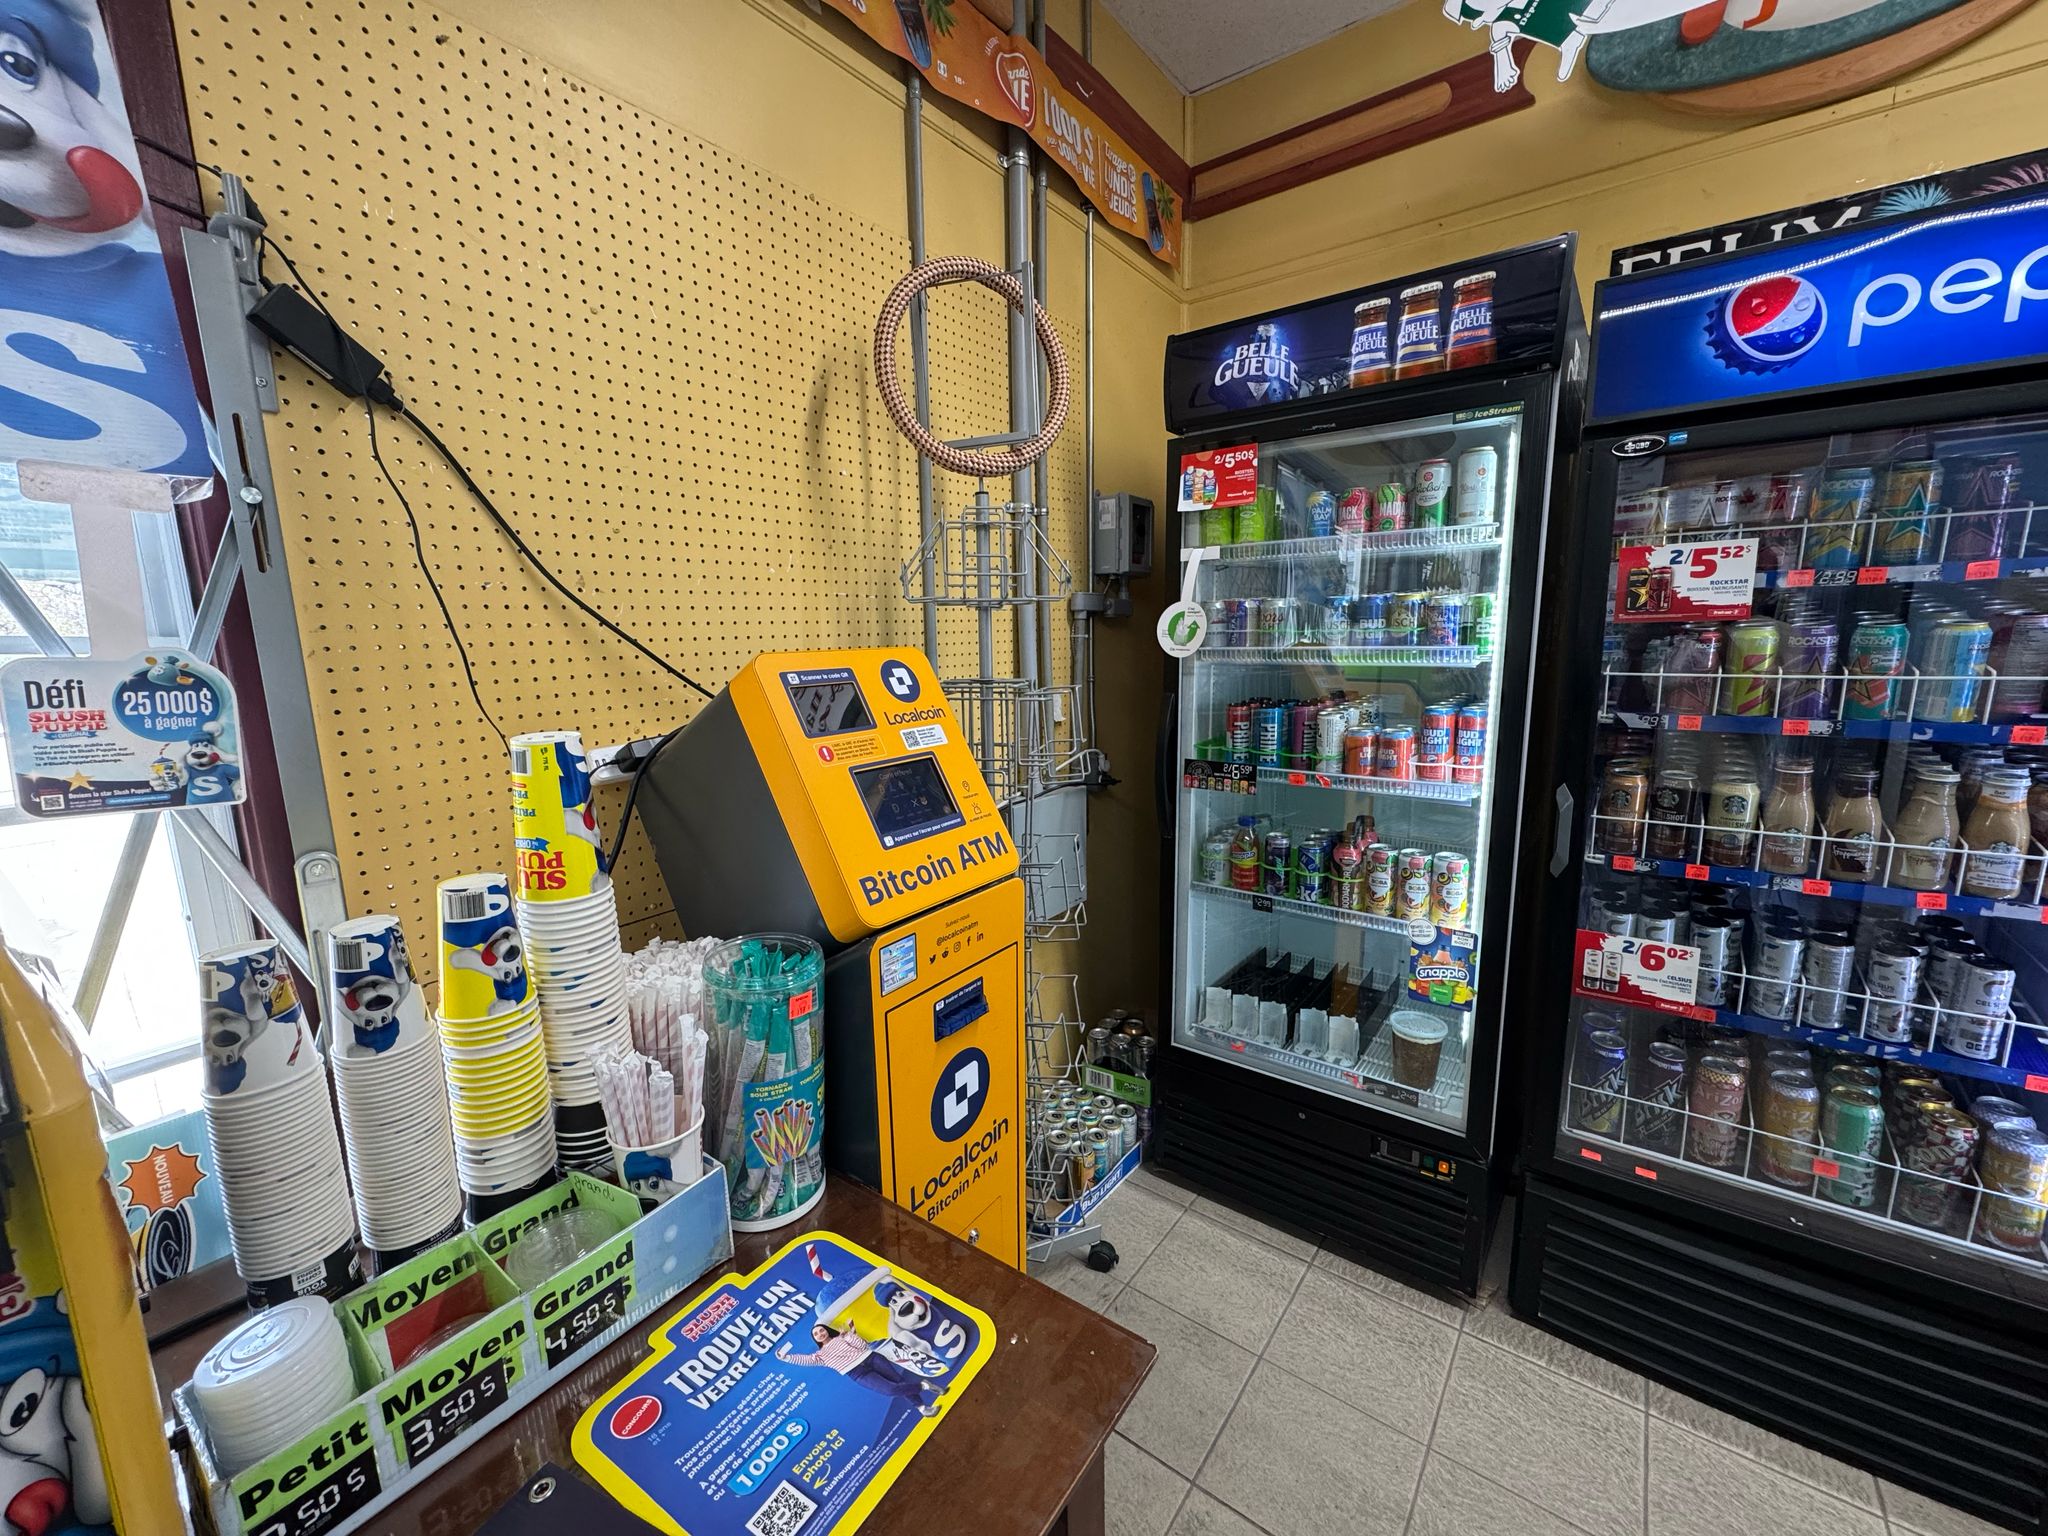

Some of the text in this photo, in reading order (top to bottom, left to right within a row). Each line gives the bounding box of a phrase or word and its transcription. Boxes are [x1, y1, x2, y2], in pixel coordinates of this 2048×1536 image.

[1104, 161, 1136, 205] LUNDIS
[1109, 197, 1138, 224] JEUDIS
[1405, 319, 1433, 334] BELLE
[1451, 312, 1493, 332] GUEULE
[1459, 307, 1488, 320] BELLE
[1234, 342, 1290, 363] BELLE
[1352, 336, 1388, 355] GUEULE
[1358, 330, 1383, 343] BELLE
[1398, 325, 1440, 346] GUEULE
[1214, 357, 1299, 392] GUEULE
[1474, 405, 1521, 418] IceStream
[1710, 578, 1749, 586] ROCKSTAR
[1359, 618, 1387, 629] BUD
[23, 679, 86, 710] Défi
[122, 691, 150, 716] 25
[29, 709, 106, 723] SLUSH
[144, 716, 198, 731] à gagner
[883, 705, 946, 726] Localcoin
[1423, 728, 1445, 737] BUD
[1458, 729, 1479, 738] BUD
[1233, 720, 1250, 763] PRIME
[1260, 723, 1278, 764] PRIME
[191, 776, 223, 797] S
[858, 831, 1009, 908] Bitcoin ATM
[936, 920, 979, 946] @localcoinatm
[1419, 966, 1466, 981] snapple
[1667, 974, 1693, 984] CELSIUS
[755, 1082, 789, 1092] TORNADO
[153, 1154, 174, 1204] NOUVEAU
[910, 1118, 1009, 1214] Localcoin
[573, 1175, 616, 1202] grand
[927, 1151, 998, 1222] Bitcoin ATM
[1082, 1168, 1121, 1211] BUD LIGHT
[533, 1240, 634, 1320] Grand
[545, 1303, 600, 1350] 4.50
[681, 1293, 734, 1337] SLUSH
[663, 1279, 797, 1395] TROUVE UN
[686, 1292, 816, 1411] VERRE GÉANT
[381, 1319, 526, 1426] Moyen
[410, 1376, 496, 1457] 3.50 $
[621, 1398, 653, 1435] CONCOURS
[674, 1372, 775, 1467] Trouve un verre géant chez
[681, 1373, 785, 1473] nos commerçants, prends ta
[688, 1378, 791, 1479] photo avec lui et soumets-la.
[699, 1480, 709, 1490] À
[708, 1451, 737, 1482] gagner
[740, 1412, 776, 1449] ensemble
[775, 1382, 807, 1413] serviette
[707, 1391, 809, 1496] et sac de plage Slush Puppie
[792, 1428, 839, 1476] Envois ta
[238, 1420, 369, 1521] Petit
[713, 1421, 804, 1500] ou $
[802, 1436, 845, 1483] photo ici
[822, 1445, 870, 1497] slushpuppie.ca
[346, 1467, 366, 1492] $
